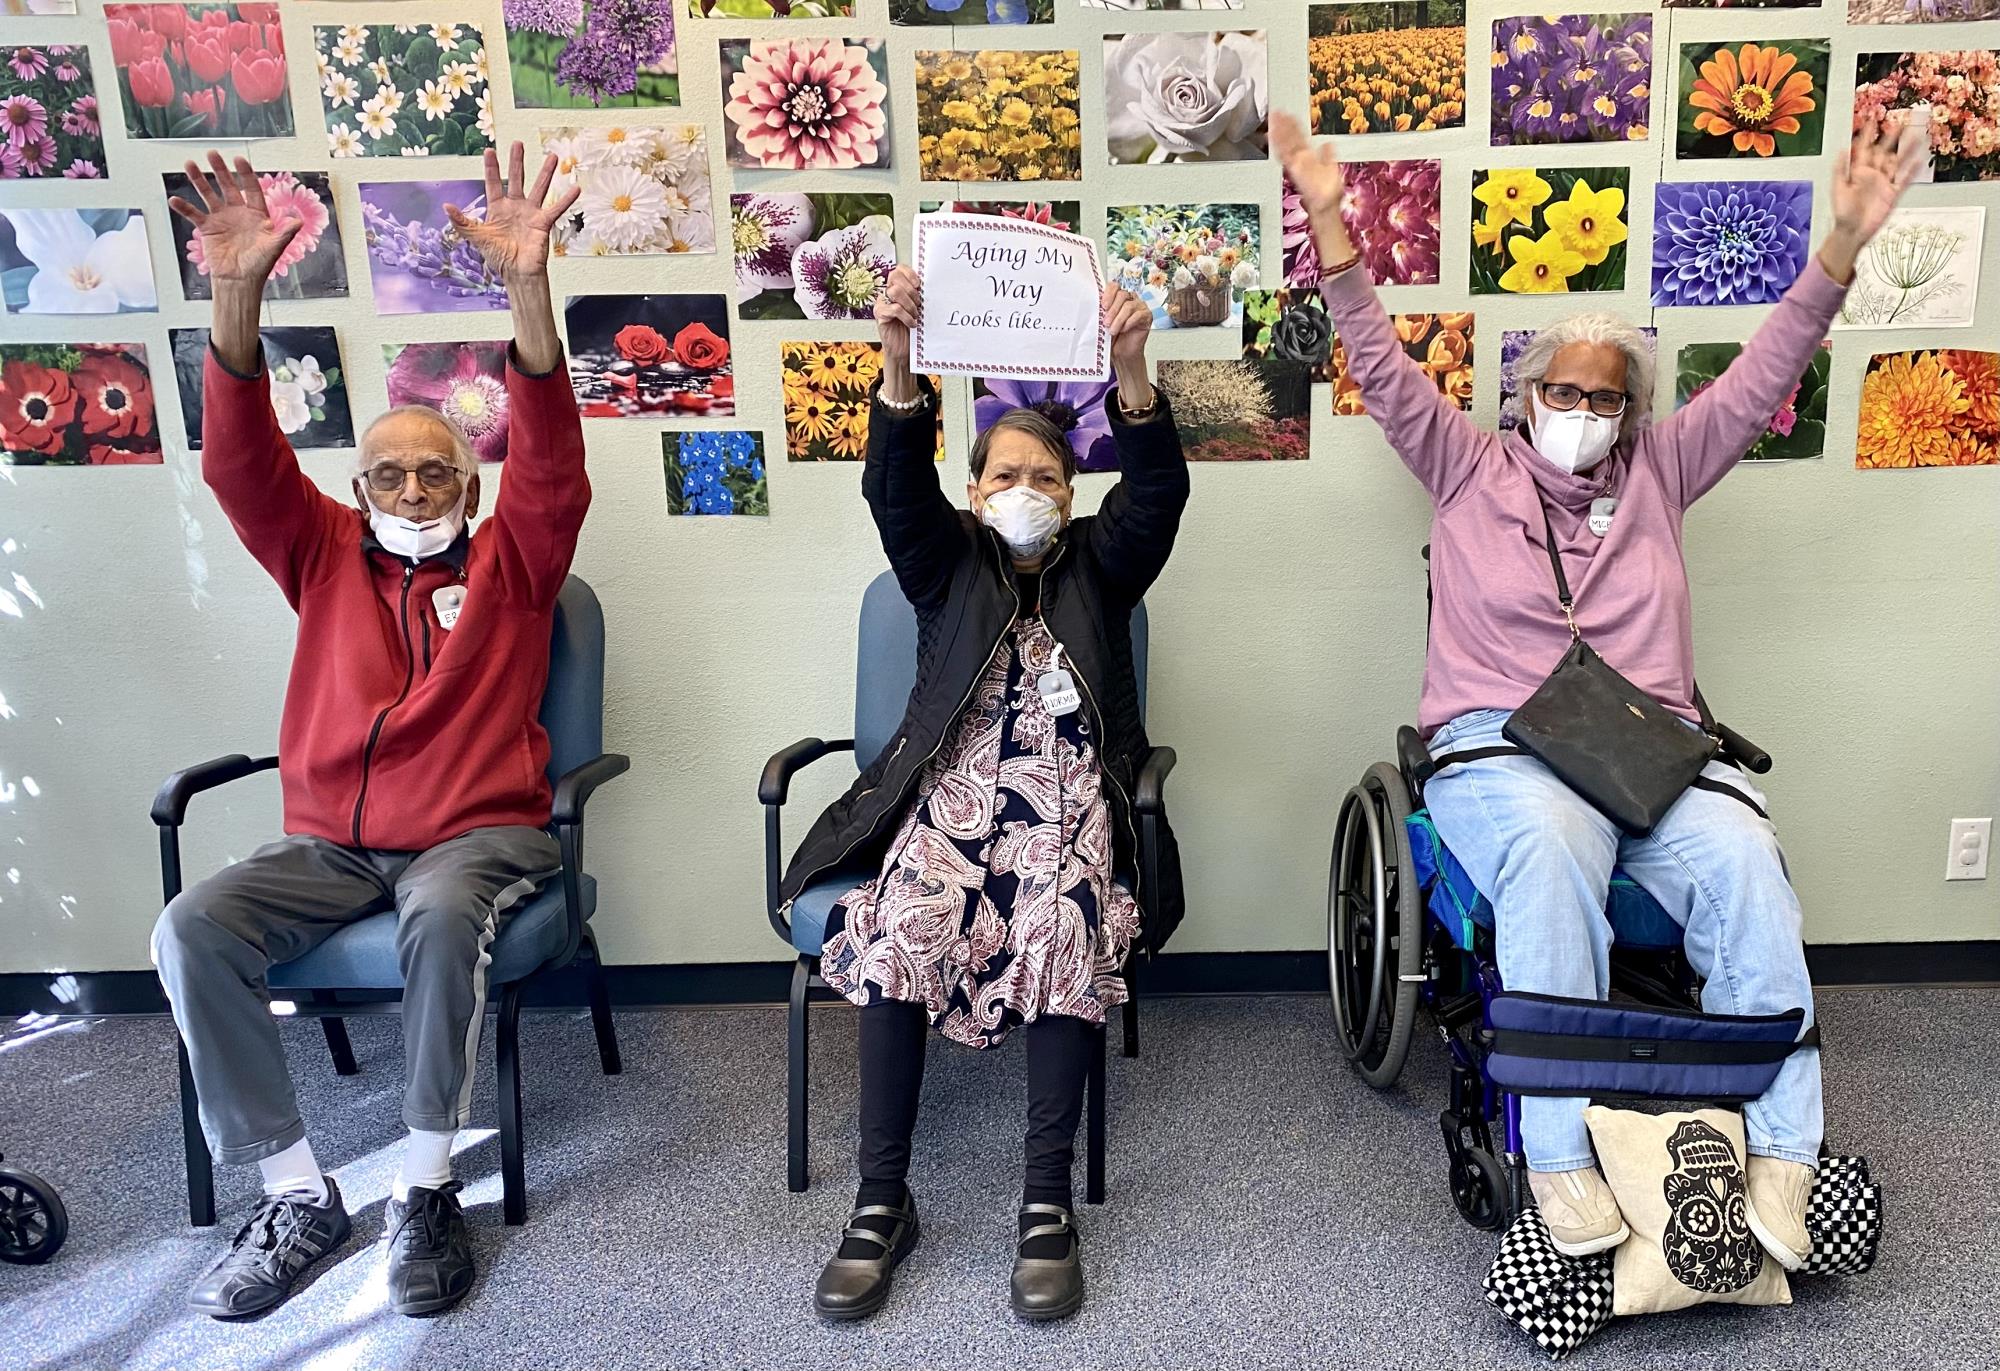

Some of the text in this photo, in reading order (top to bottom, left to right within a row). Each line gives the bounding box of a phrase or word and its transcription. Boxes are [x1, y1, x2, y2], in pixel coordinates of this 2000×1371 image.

[951, 241, 1073, 273] Aging My
[985, 275, 1044, 307] Way
[946, 310, 1001, 328] Looks
[1044, 693, 1076, 710] NORMA
